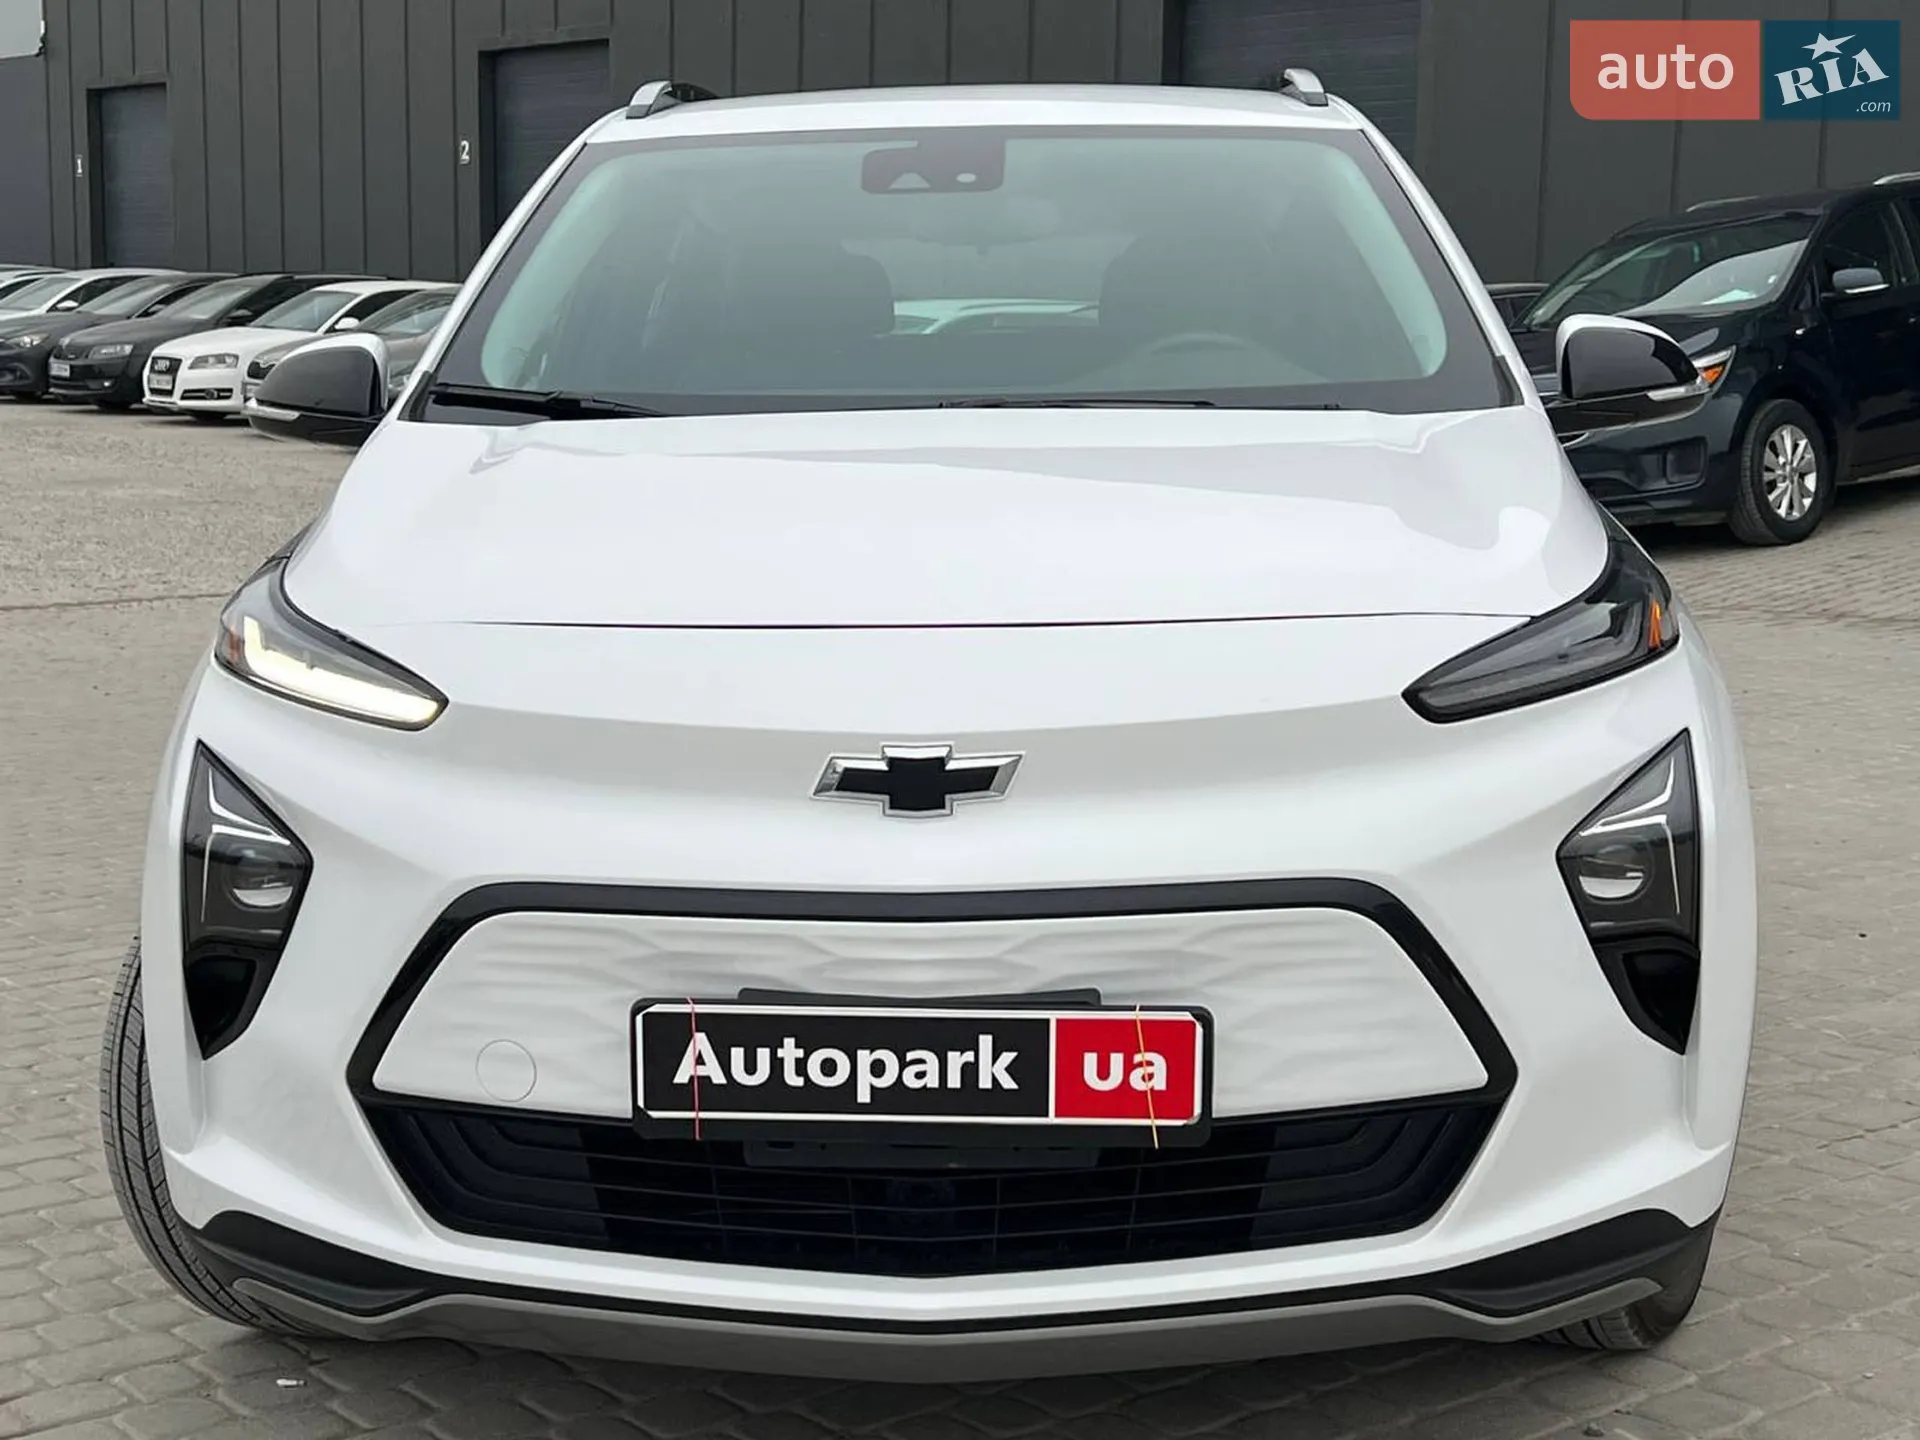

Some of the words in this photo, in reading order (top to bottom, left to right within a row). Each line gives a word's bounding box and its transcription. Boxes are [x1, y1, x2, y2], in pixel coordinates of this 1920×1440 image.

[460, 139, 470, 160] 2
[672, 1031, 1020, 1104] Autopark
[1082, 1050, 1168, 1092] ua
